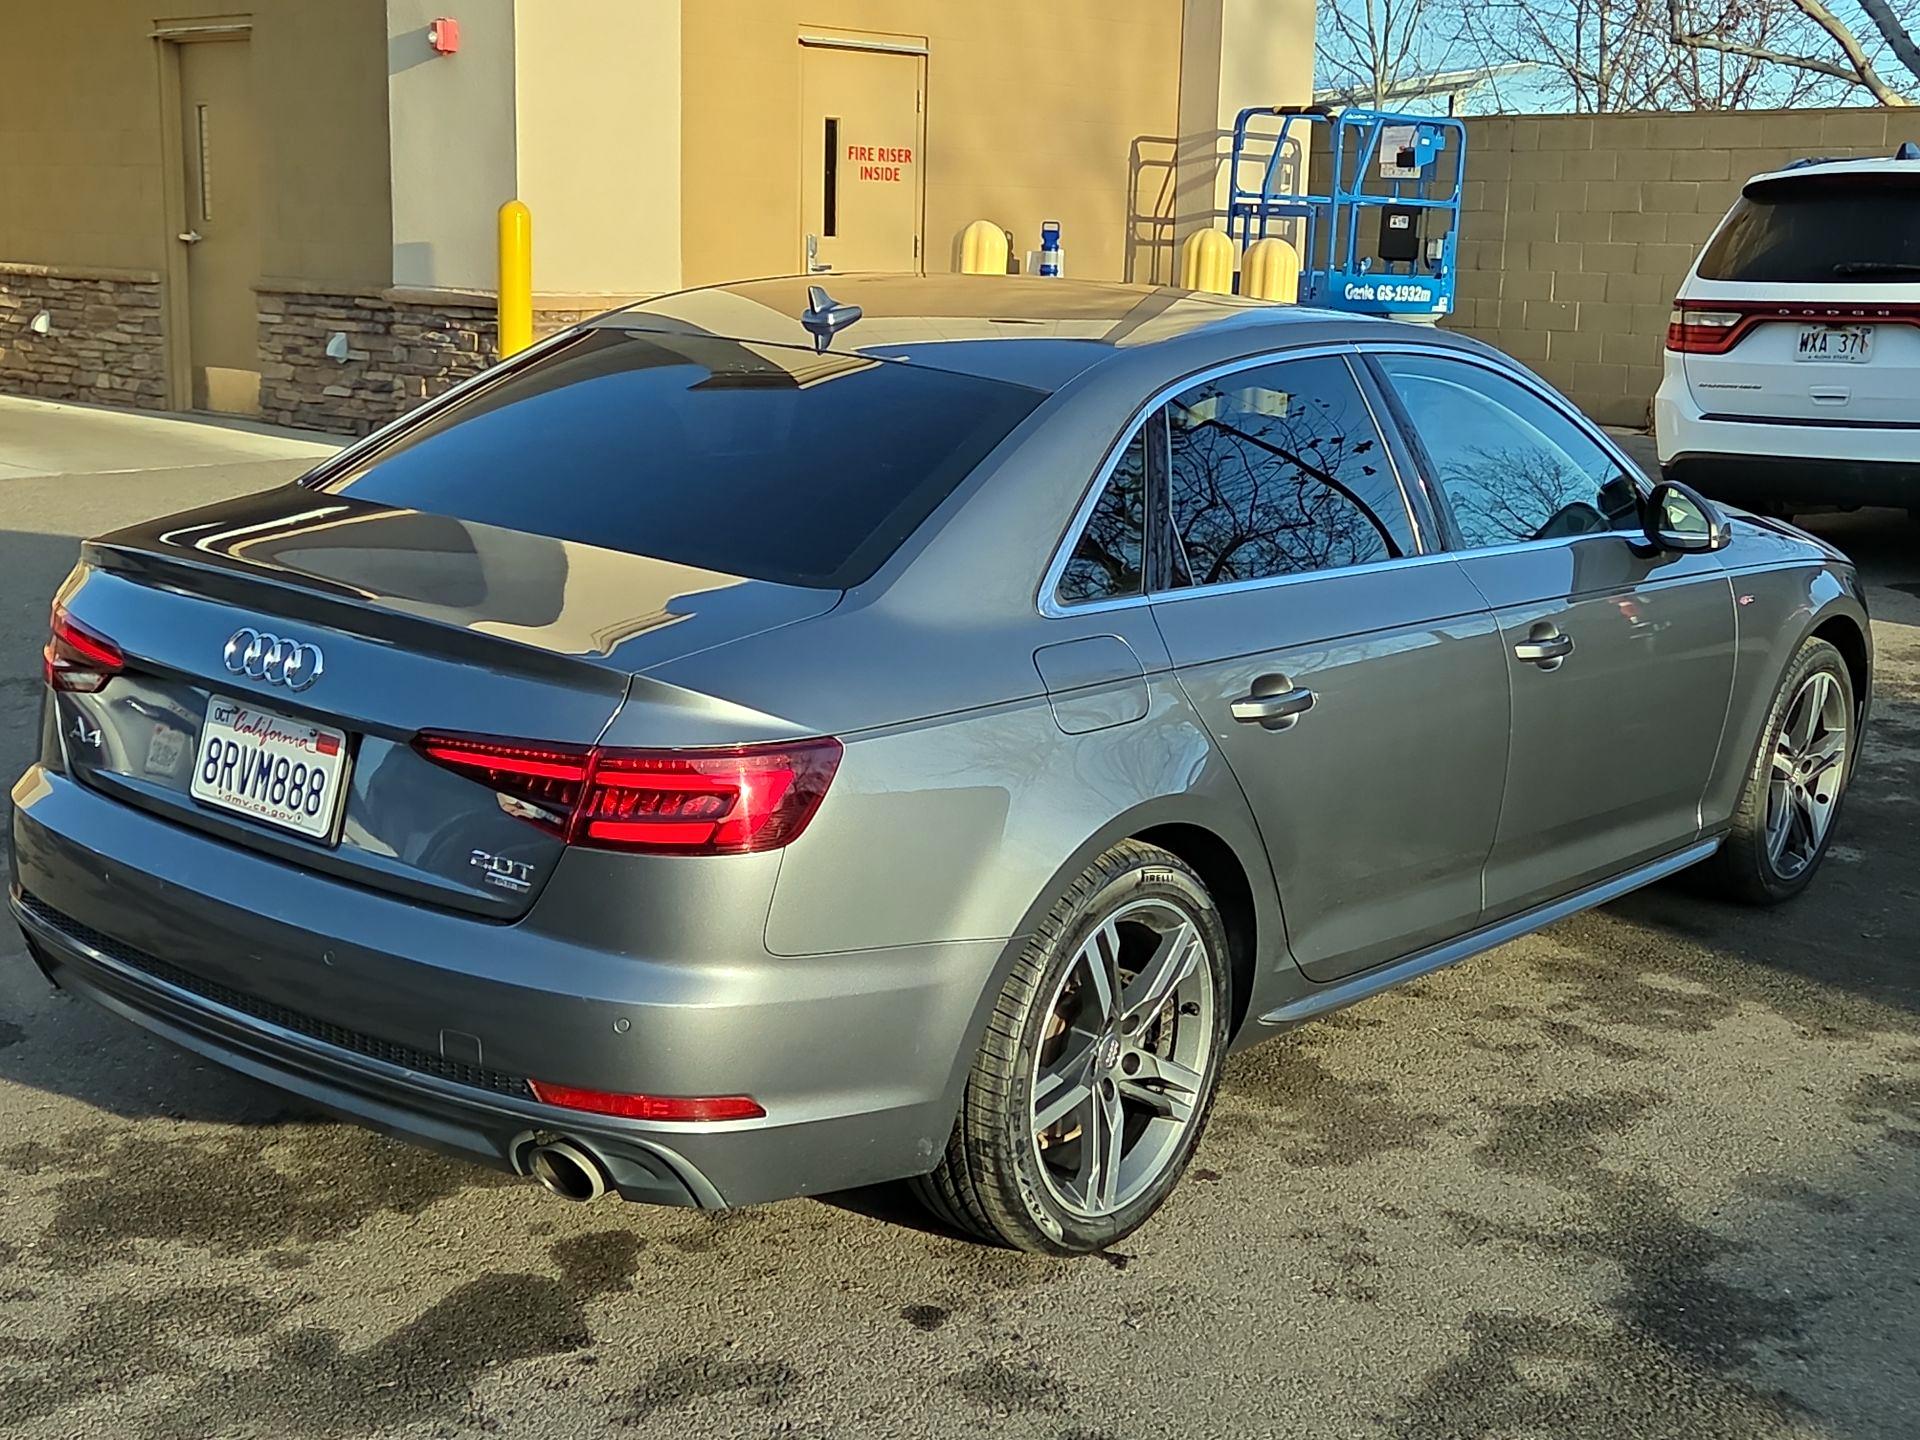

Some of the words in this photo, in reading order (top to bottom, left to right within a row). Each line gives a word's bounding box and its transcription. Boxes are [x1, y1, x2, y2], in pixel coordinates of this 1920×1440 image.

[848, 146, 875, 161] FIRE
[878, 147, 912, 163] RISER
[860, 166, 901, 182] INSIDE
[1799, 332, 1827, 353] WXA
[214, 707, 232, 723] OCT
[69, 715, 102, 748] A4
[233, 711, 316, 754] California
[203, 737, 326, 817] 8RVM888
[224, 793, 294, 821] dmv.ca.gov
[1141, 868, 1174, 883] PIRELLI
